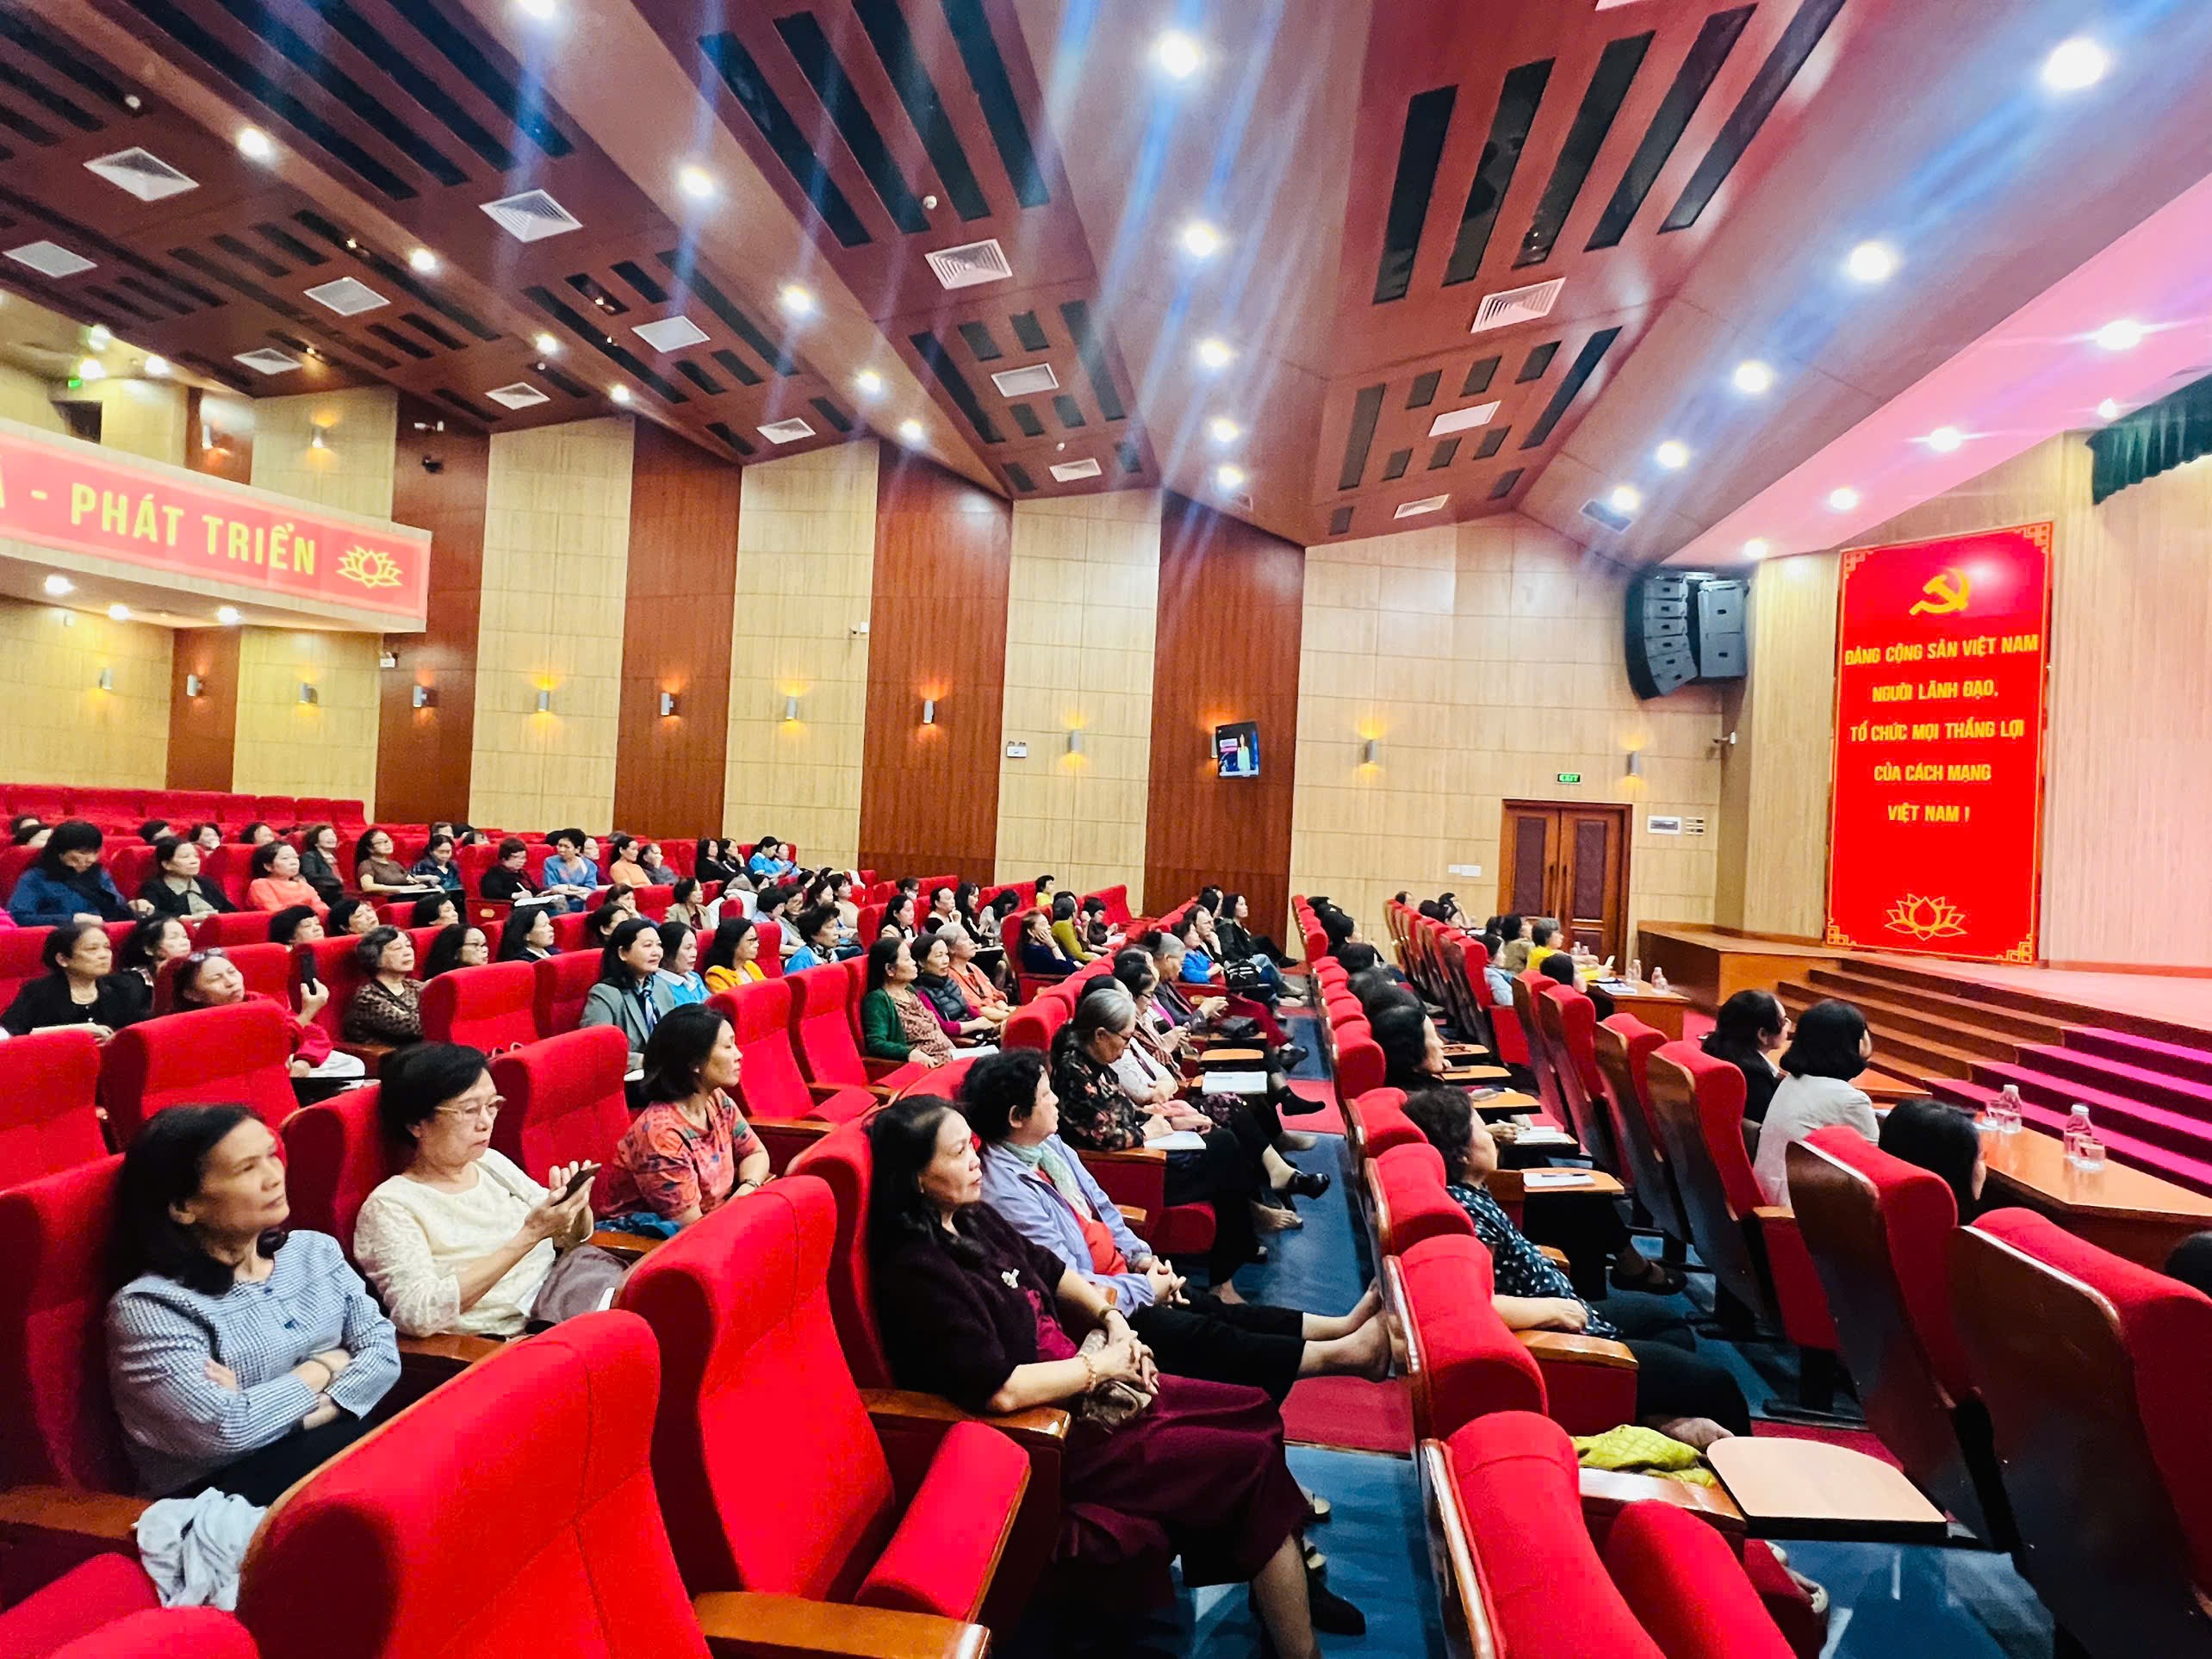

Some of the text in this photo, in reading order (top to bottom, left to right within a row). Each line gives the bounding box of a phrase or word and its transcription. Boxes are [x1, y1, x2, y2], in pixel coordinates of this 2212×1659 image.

[71, 482, 184, 546] PHÁT
[202, 515, 315, 575] TRIỂN
[1844, 634, 2039, 666] ĐẢNG CỘNG SẢN VIỆT NAM
[1872, 682, 1913, 702] NGƯỜI
[1918, 680, 1958, 699] LÃNH
[1871, 722, 1908, 742] CHỨC
[1911, 724, 1939, 742] MỌI
[2000, 718, 2025, 740] LỢI
[1873, 761, 1992, 783] CỦA CÁCH MẠNG
[1887, 802, 1920, 823] VIỆT
[1924, 805, 1960, 823] NAM
